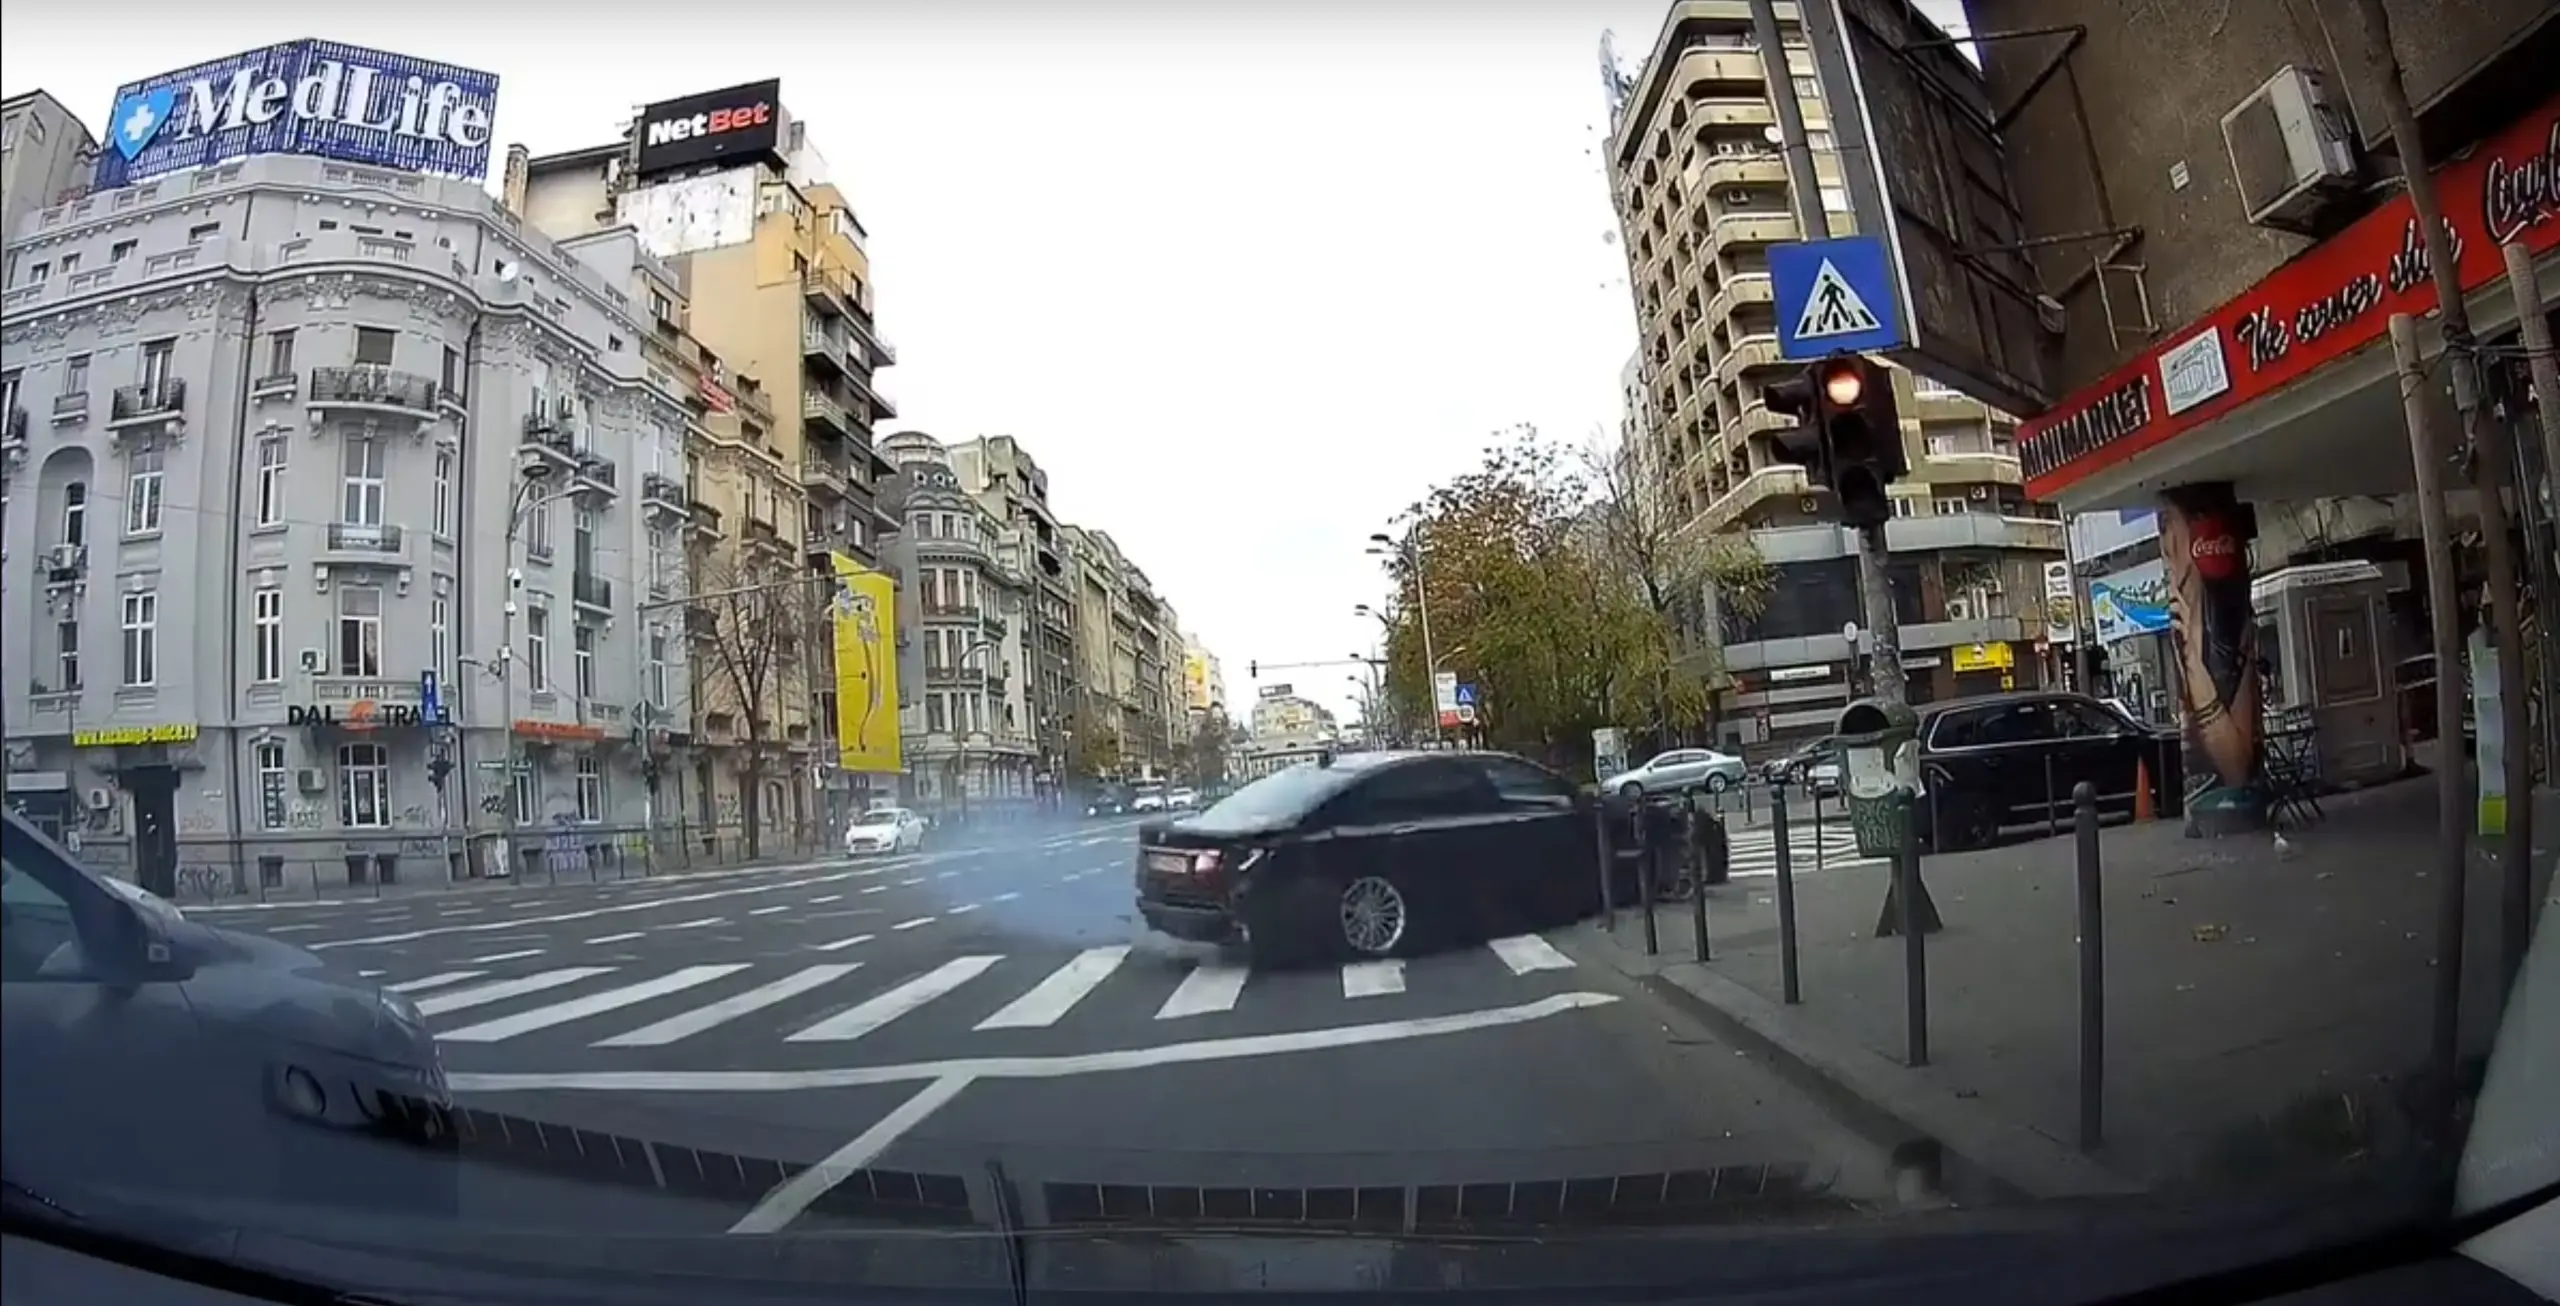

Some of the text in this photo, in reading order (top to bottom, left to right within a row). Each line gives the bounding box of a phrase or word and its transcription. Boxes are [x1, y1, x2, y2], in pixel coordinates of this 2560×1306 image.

[179, 60, 490, 148] MedLife
[649, 101, 770, 145] NetBet
[2237, 304, 2289, 372] The
[2296, 272, 2384, 344] corner
[2019, 373, 2151, 482] MINIMARKET
[288, 704, 453, 727] DAL TRAEL
